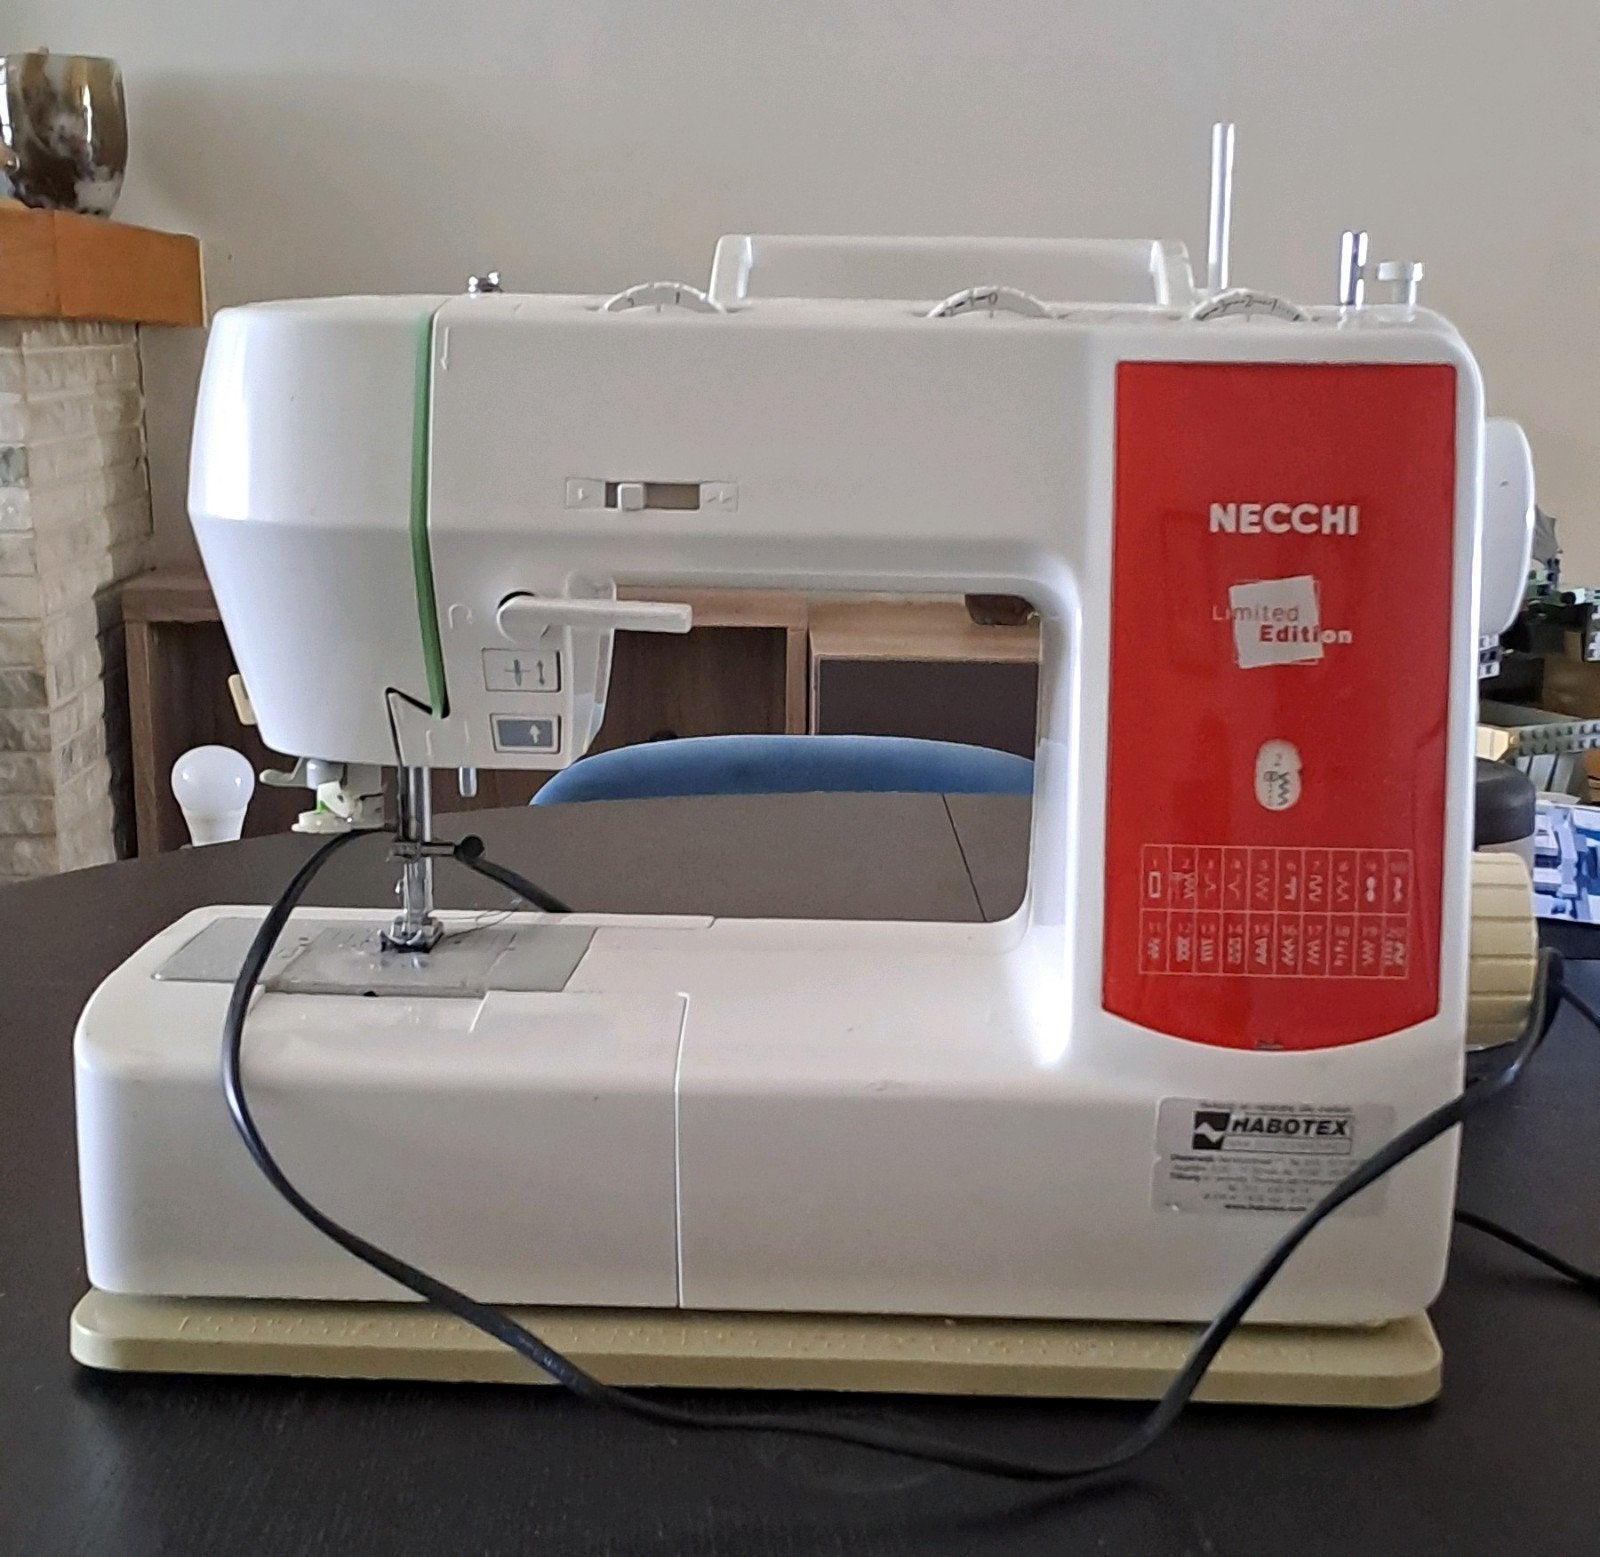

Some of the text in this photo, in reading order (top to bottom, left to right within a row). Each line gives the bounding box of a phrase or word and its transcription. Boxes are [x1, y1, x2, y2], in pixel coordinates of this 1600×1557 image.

[1209, 502, 1359, 536] NECCHI
[1212, 604, 1300, 622] Limited
[1260, 624, 1353, 644] Edition
[1231, 1116, 1349, 1137] HABOTEX
